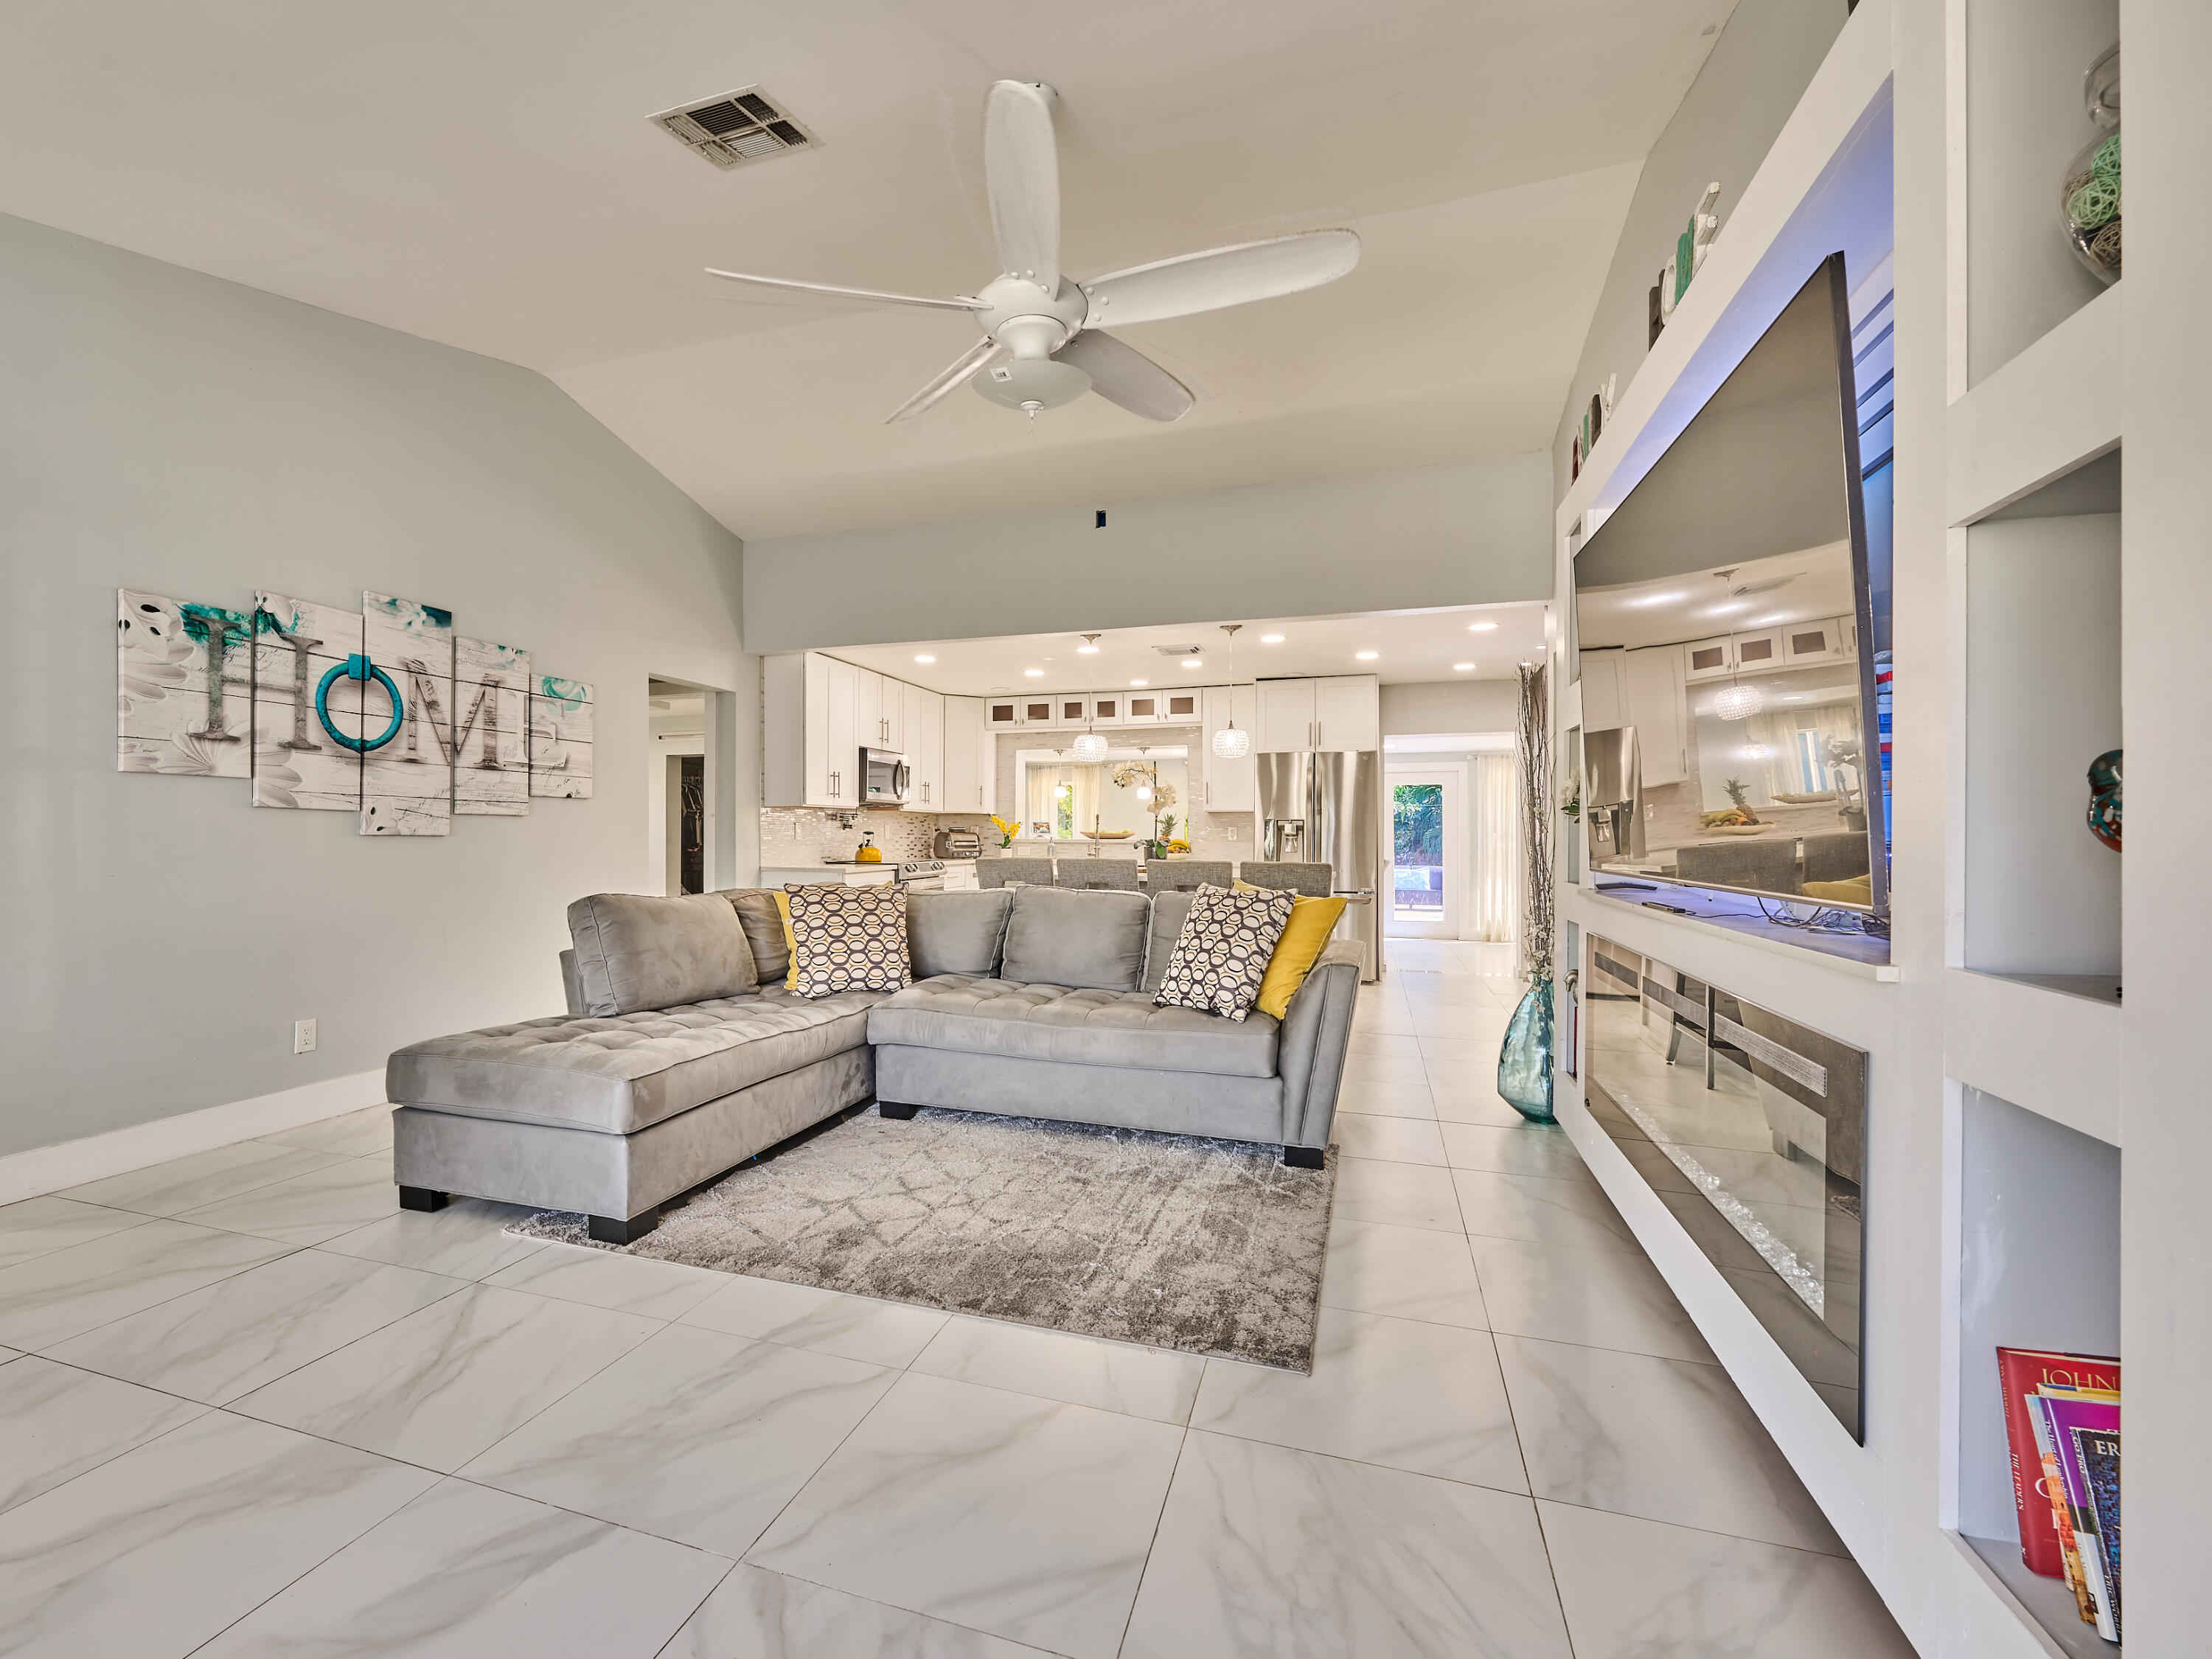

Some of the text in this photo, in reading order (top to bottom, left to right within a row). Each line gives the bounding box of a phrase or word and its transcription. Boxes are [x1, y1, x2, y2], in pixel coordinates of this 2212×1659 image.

[189, 612, 569, 770] HOME
[2042, 1368, 2115, 1391] JOHN
[2073, 1436, 2081, 1453] GO
